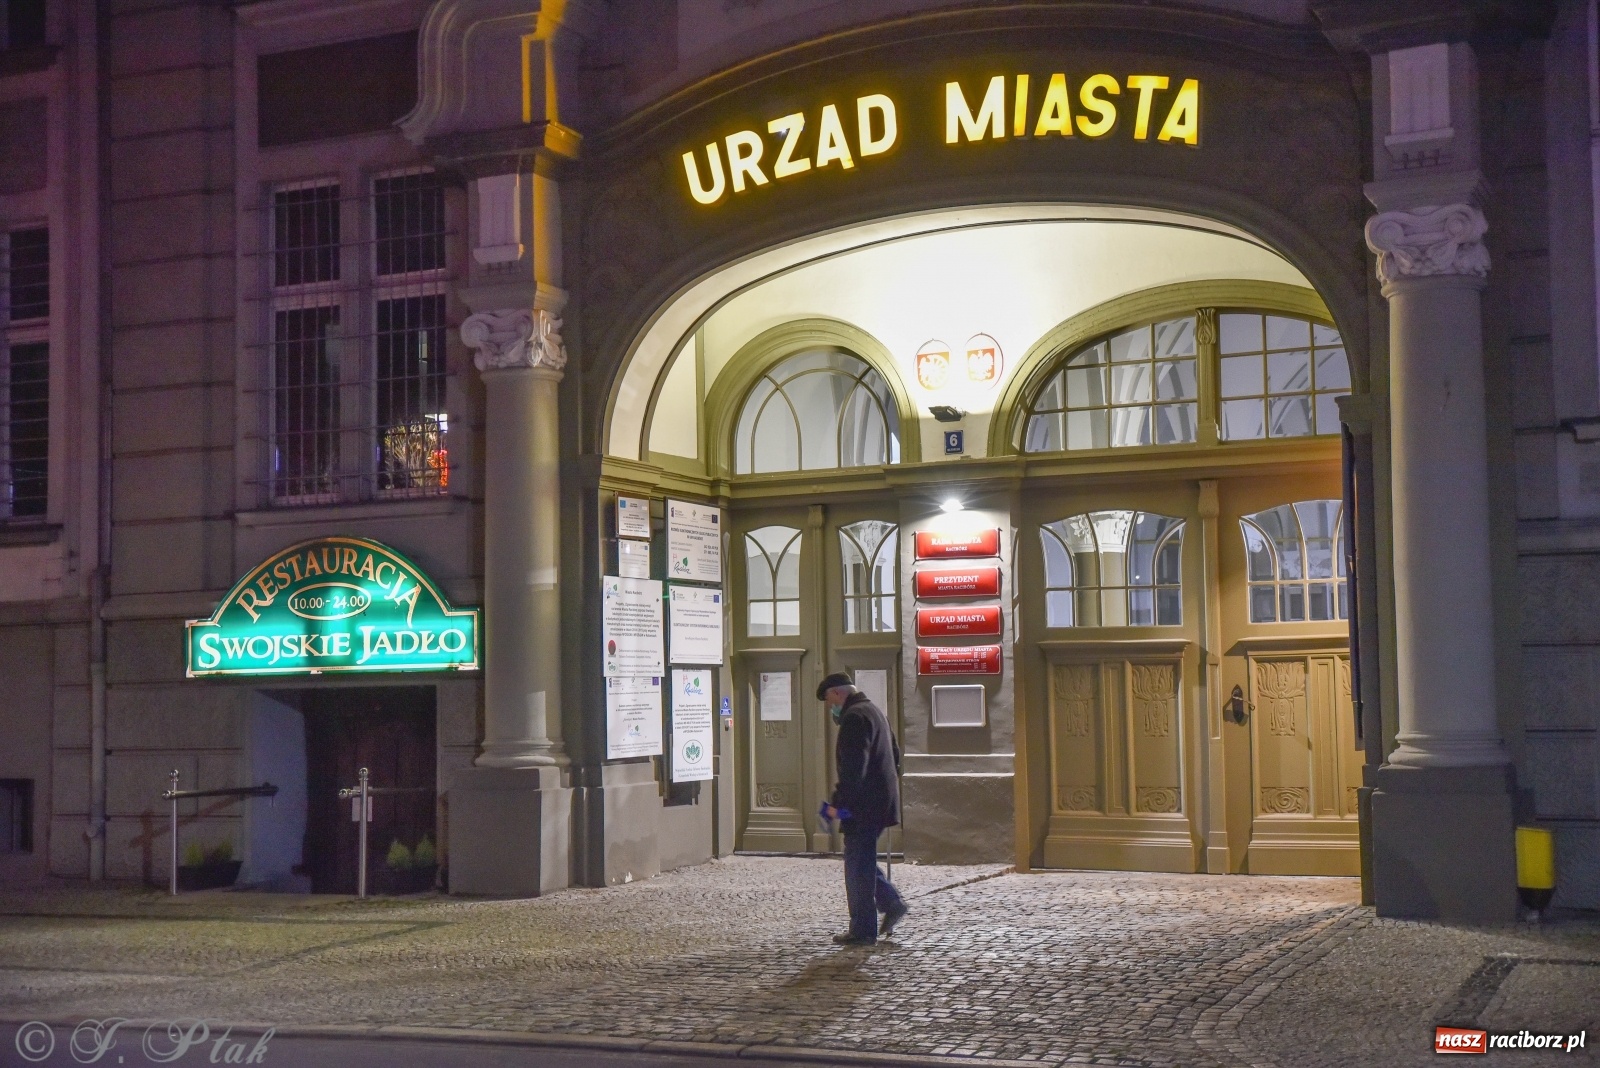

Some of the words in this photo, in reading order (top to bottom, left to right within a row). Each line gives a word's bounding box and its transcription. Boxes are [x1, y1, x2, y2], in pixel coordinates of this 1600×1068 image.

[682, 93, 897, 204] URZĄD
[946, 73, 1198, 145] MIASTA
[950, 434, 958, 447] 6
[236, 547, 422, 628] RESTAURACJA
[934, 575, 979, 583] PREZYDENT
[930, 616, 956, 624] URZĄD
[957, 615, 986, 623] MIASTA
[198, 633, 350, 668] SWOJSKIE
[356, 625, 466, 664] JADŁO
